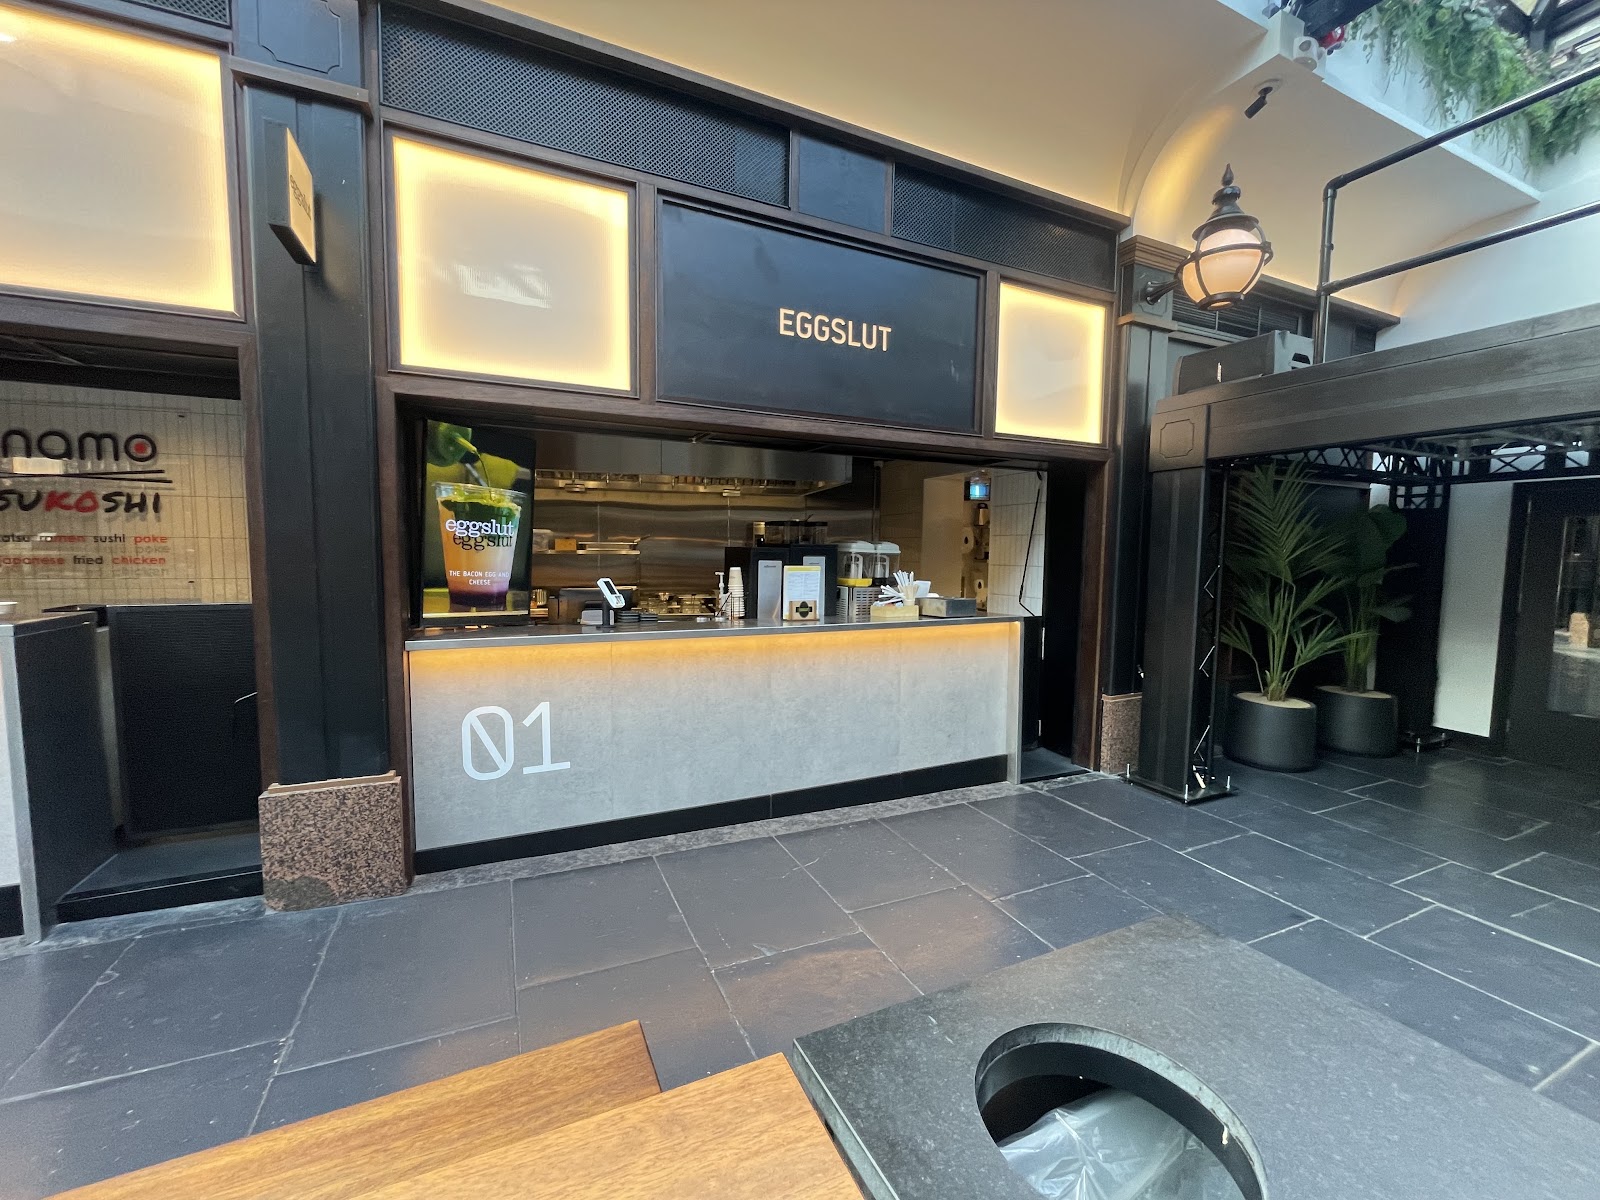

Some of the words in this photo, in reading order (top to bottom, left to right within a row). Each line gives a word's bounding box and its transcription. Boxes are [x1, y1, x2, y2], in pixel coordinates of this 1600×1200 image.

[779, 307, 892, 352] EGGSLUT
[1, 429, 157, 463] namo
[0, 534, 31, 543] atsu
[93, 533, 126, 543] sushi
[133, 534, 168, 545] poke
[445, 519, 514, 538] eggslut
[0, 556, 65, 567] apanese
[73, 555, 104, 565] fried
[112, 556, 166, 565] chicken
[461, 701, 571, 780] 01
